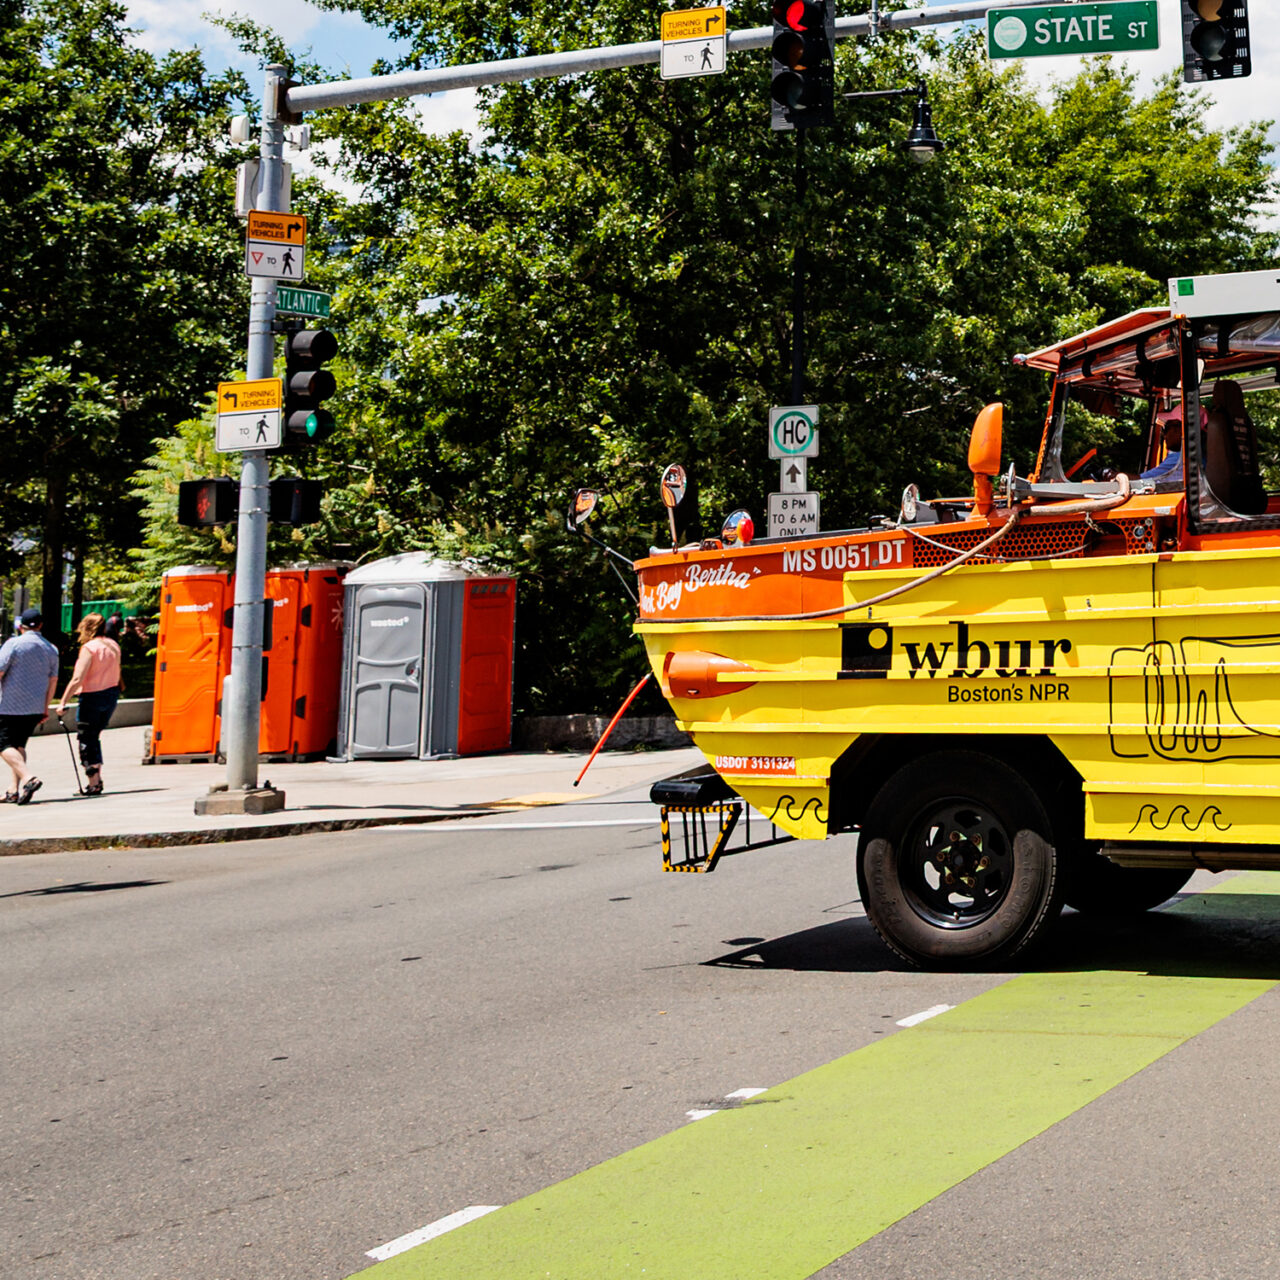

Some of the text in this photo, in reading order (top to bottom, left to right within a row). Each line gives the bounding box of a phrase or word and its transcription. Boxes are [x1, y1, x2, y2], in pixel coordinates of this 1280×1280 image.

[667, 19, 701, 29] TURNING
[1034, 14, 1148, 44] STATE ST
[665, 26, 703, 38] VEHICLES
[683, 54, 695, 63] TO
[252, 220, 284, 230] TURNING
[250, 229, 285, 240] VEHICLES
[266, 256, 277, 265] TO
[276, 290, 321, 313] ATLANTIC
[242, 389, 276, 400] TURNING
[240, 398, 277, 408] VEHICLES
[239, 427, 250, 436] TO
[782, 419, 807, 445] HC
[781, 499, 807, 510] 8 PM
[772, 513, 816, 524] TO 6 AM
[783, 539, 905, 573] MS 0051 DT
[656, 581, 682, 610] Bay
[900, 621, 1072, 679] wbur
[948, 683, 1070, 703] Boston's NPR
[715, 756, 796, 770] USDOT 3131324
